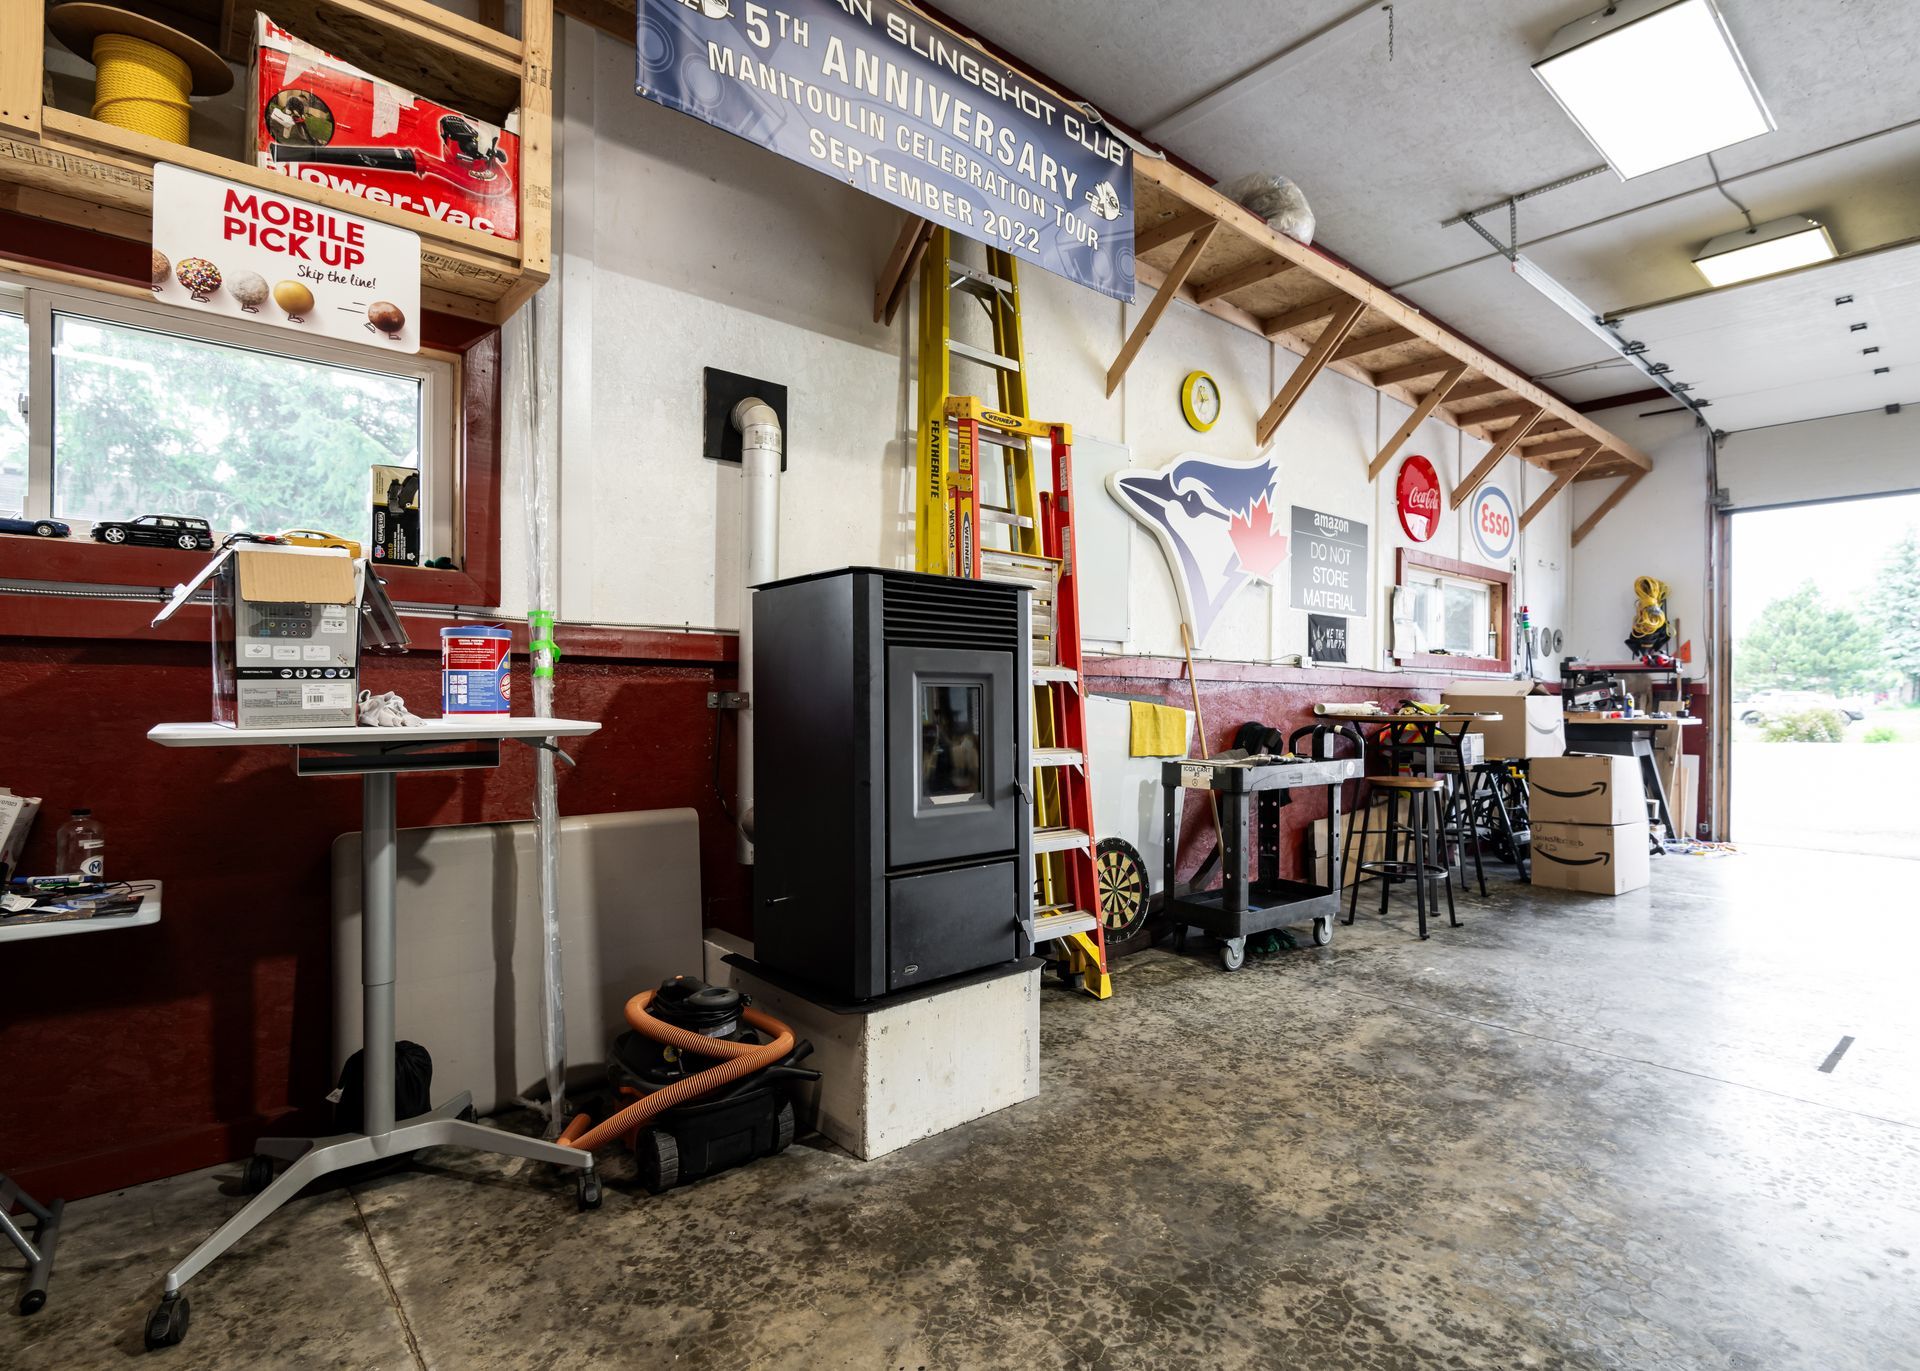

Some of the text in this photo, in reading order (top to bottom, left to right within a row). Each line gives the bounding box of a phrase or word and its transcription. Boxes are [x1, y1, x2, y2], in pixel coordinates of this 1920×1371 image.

[745, 1, 1078, 200] 5TH ANNIVERSARY
[887, 12, 1056, 126] SLINGSHOT
[1064, 113, 1124, 167] CLUB
[707, 41, 1099, 251] MANITOULIN CELEBRATION TOUR
[223, 188, 365, 248] MOBILE
[809, 127, 1040, 254] SEPTEMBER 2022
[223, 215, 365, 270] PICK UP
[297, 264, 377, 290] Skip the line!
[930, 419, 940, 499] FEATHERLITE
[1314, 513, 1349, 533] amazon
[1310, 541, 1352, 565] DO NOT
[1312, 566, 1349, 588] STORE
[1303, 587, 1357, 612] MATERIAL
